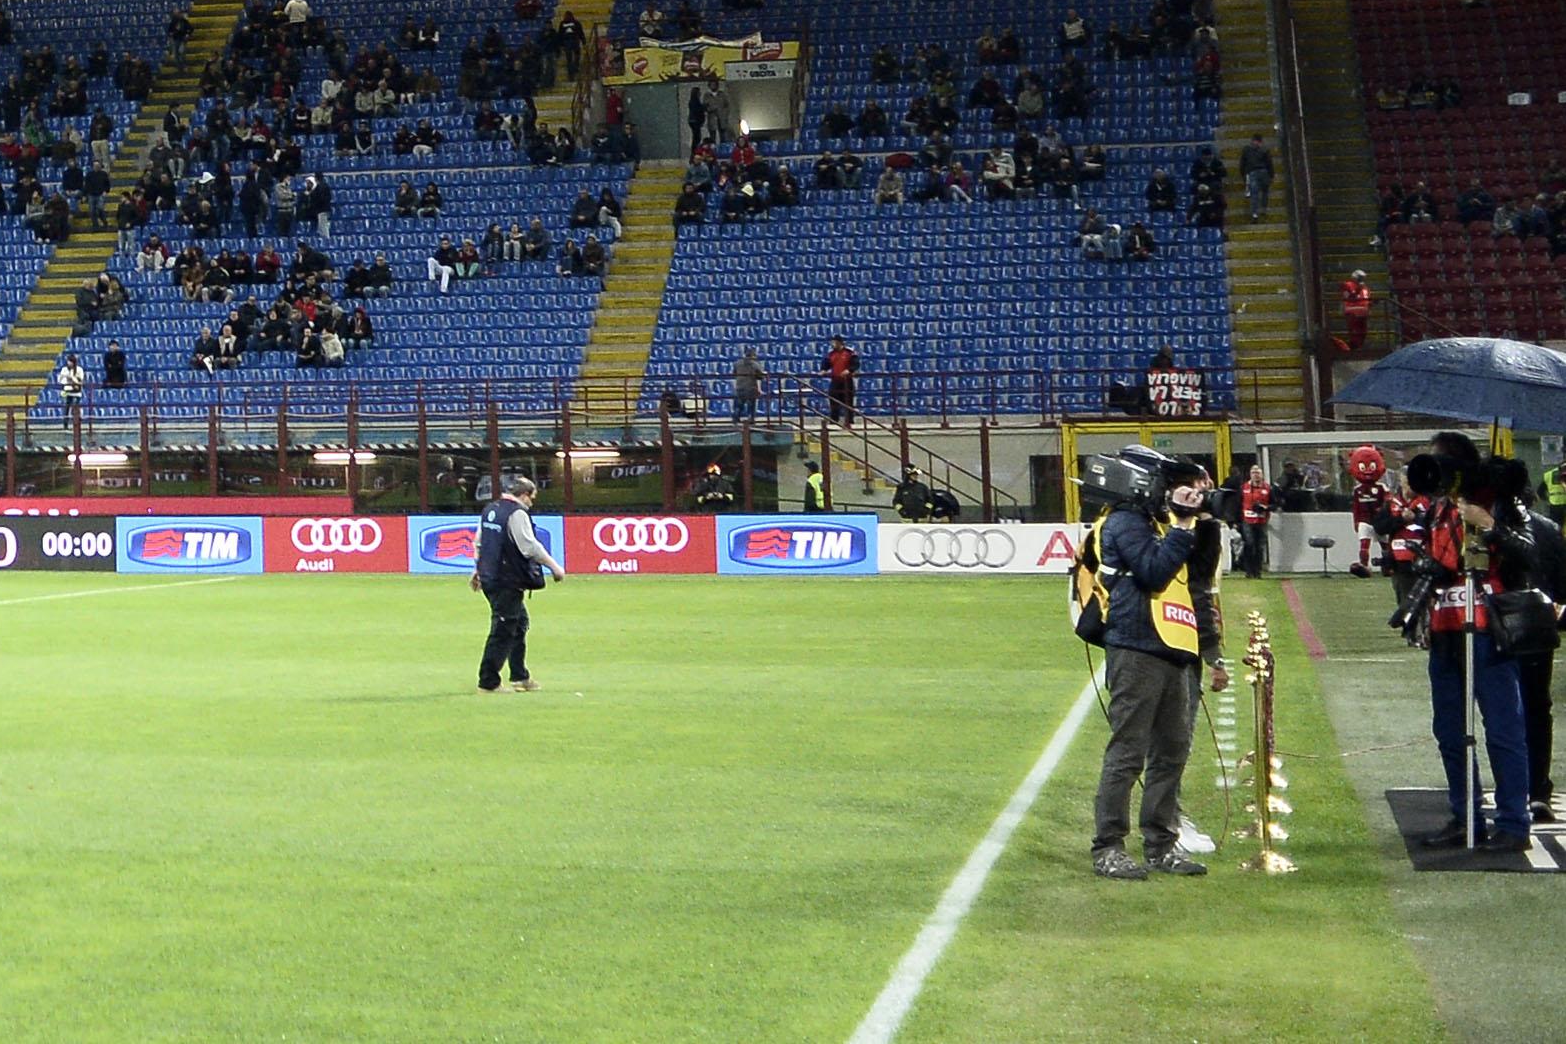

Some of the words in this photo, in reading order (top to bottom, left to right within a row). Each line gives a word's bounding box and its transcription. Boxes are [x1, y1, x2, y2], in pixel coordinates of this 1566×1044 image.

[1147, 372, 1202, 386] MAGLIA
[1149, 385, 1169, 401] LA
[1171, 385, 1202, 401] PER
[1158, 401, 1202, 416] SLO
[42, 532, 113, 557] 00:00
[184, 531, 239, 560] TIM
[792, 531, 852, 559] TIM
[296, 558, 334, 572] Audi
[598, 558, 638, 572] Audi
